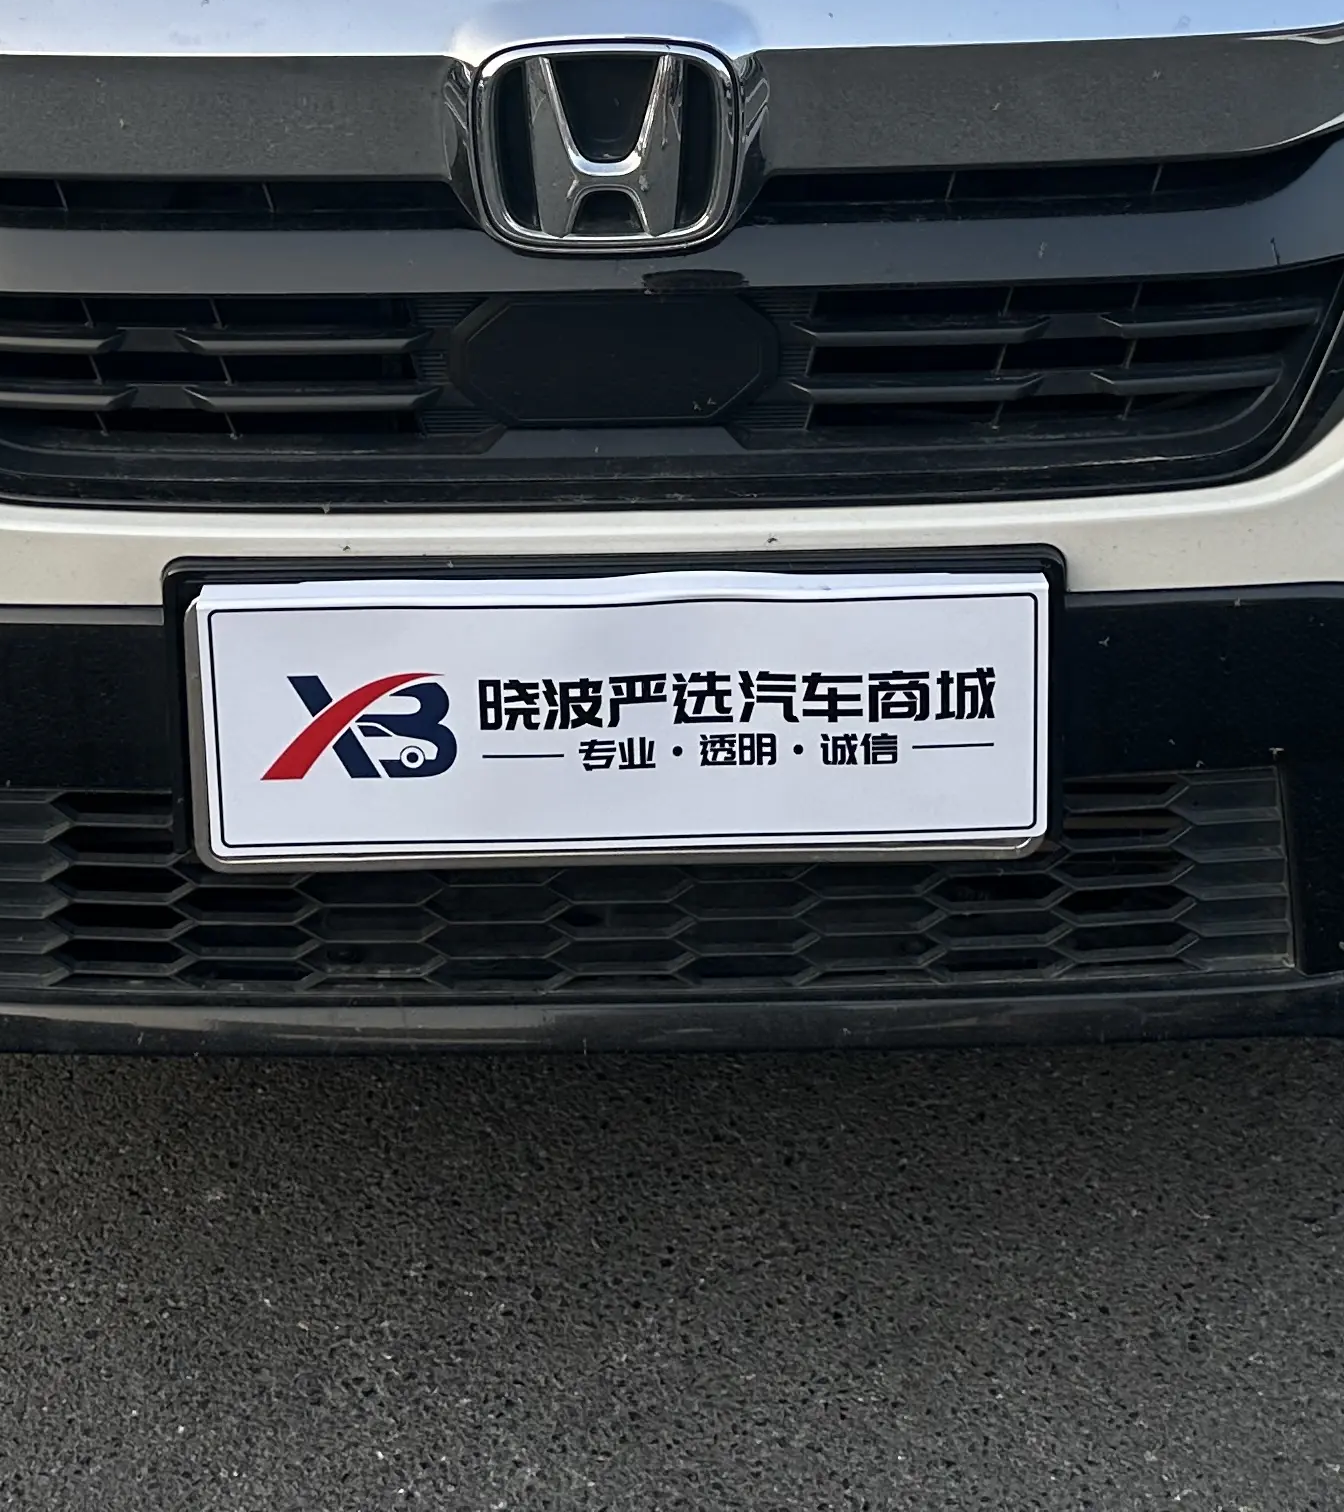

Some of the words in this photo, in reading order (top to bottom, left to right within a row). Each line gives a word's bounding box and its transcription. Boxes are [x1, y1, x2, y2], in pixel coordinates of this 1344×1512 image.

[260, 671, 458, 780] XB
[478, 666, 997, 732] 晓波严选汽车商城
